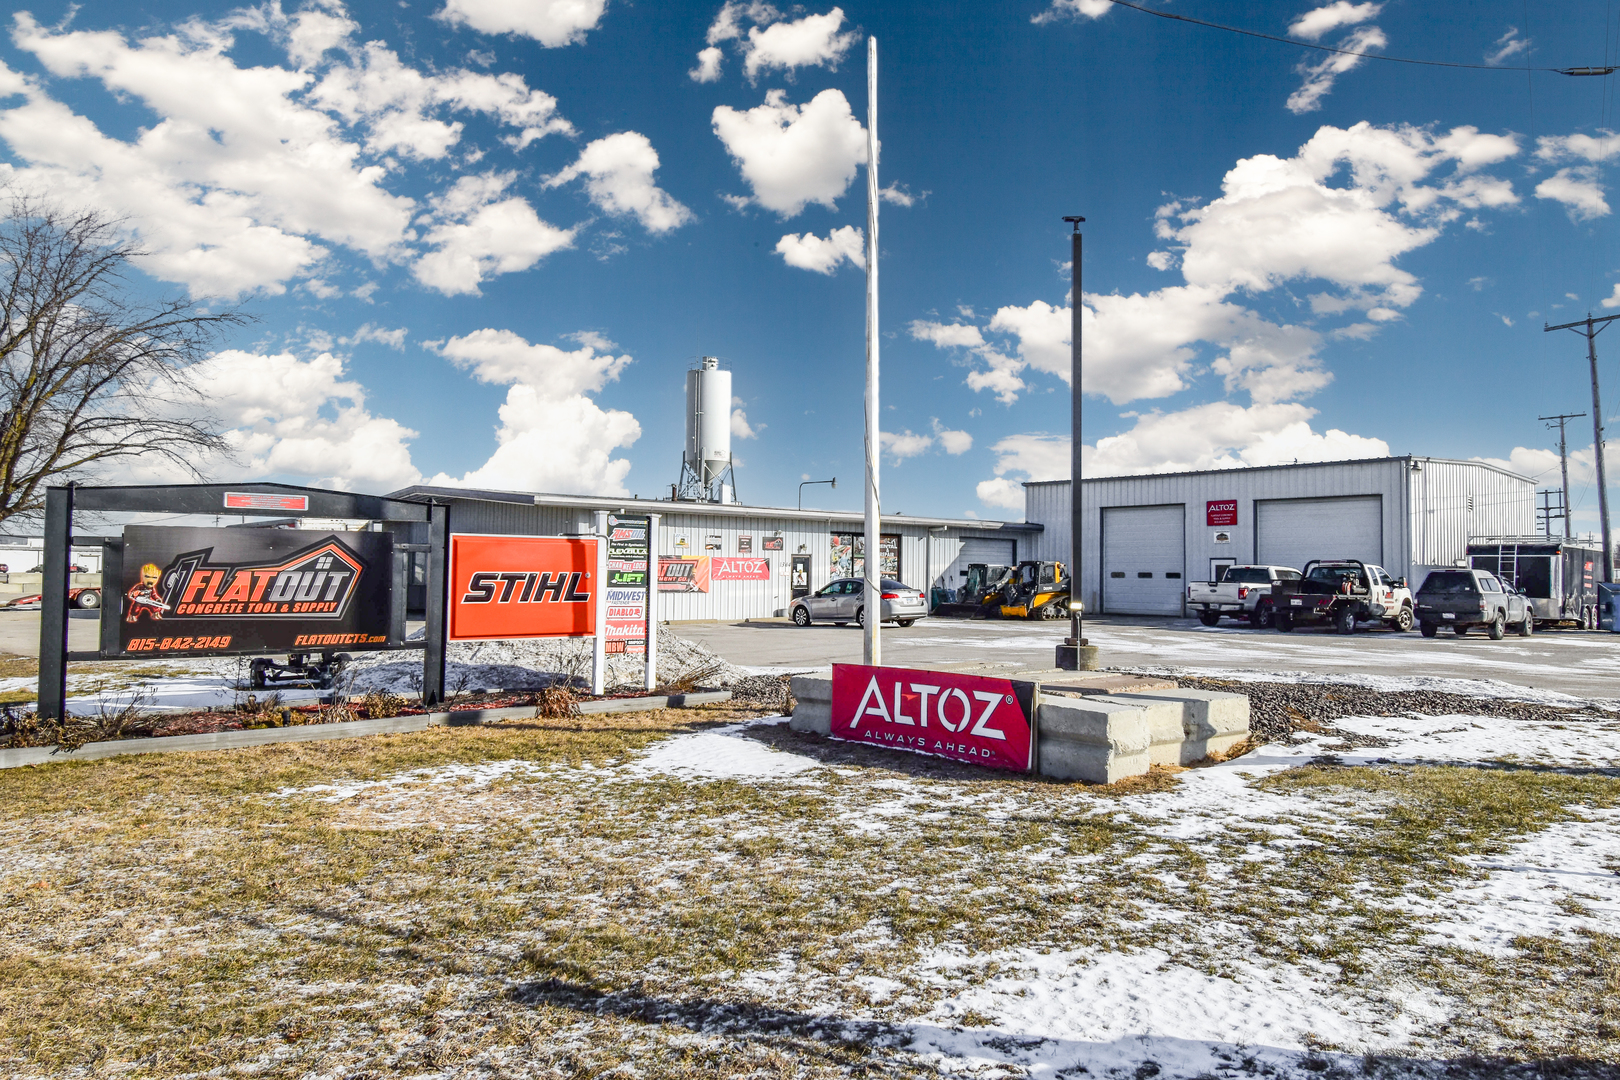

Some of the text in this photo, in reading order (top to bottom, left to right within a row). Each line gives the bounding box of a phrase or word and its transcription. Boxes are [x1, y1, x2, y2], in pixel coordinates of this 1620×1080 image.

[1208, 504, 1235, 513] ALTOZ
[611, 529, 645, 540] AMSOIL
[718, 560, 763, 576] ALTOZ
[615, 573, 644, 582] LIFT
[181, 570, 350, 602] FLATOUT
[461, 571, 592, 604] STIHL
[606, 591, 646, 601] MIDWEST
[176, 601, 337, 615] CONCRETE TOOL & SUPPLY
[609, 608, 633, 616] DIABLO
[126, 633, 386, 651] 815-842-2149 FLATOUTCTS.com
[606, 641, 624, 652] MBW
[849, 674, 1006, 740] ALTOZ
[864, 729, 991, 758] ALWAYS AHEAD
